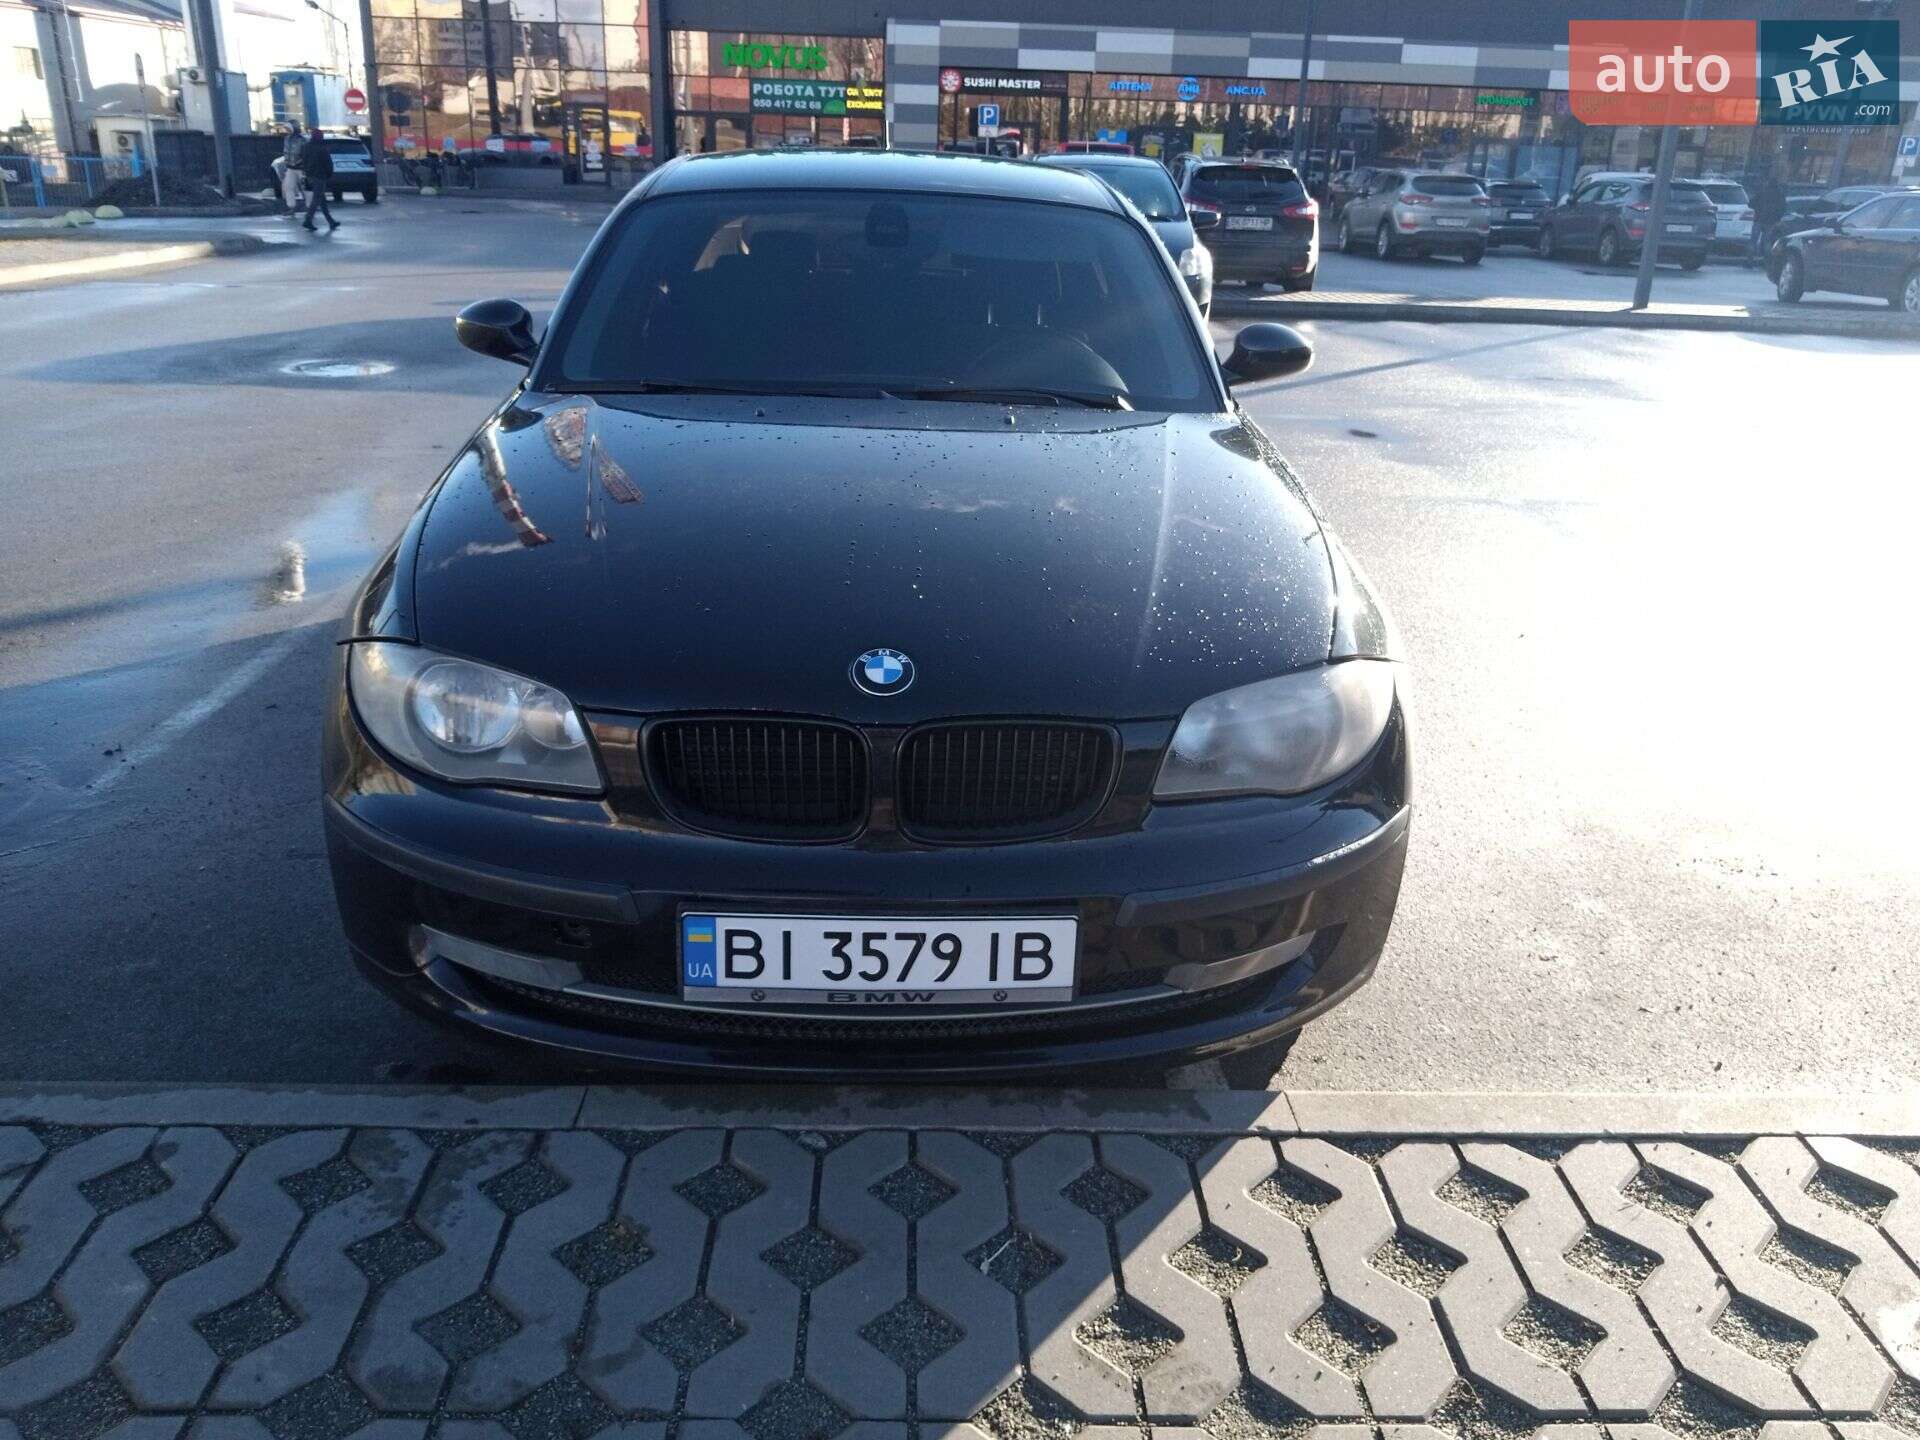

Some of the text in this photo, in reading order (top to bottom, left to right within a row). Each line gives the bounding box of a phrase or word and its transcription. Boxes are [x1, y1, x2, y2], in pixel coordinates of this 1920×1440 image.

[721, 41, 828, 71] NOVUS
[752, 83, 815, 97] РОБОТА
[818, 86, 846, 98] ТУТ
[963, 77, 996, 88] SUSHI
[998, 79, 1041, 89] MASTER
[982, 106, 995, 124] P
[1902, 137, 1916, 154] P
[859, 648, 911, 663] BMW
[821, 930, 963, 983] 3579
[688, 963, 713, 979] UA
[826, 990, 937, 1004] BMW
